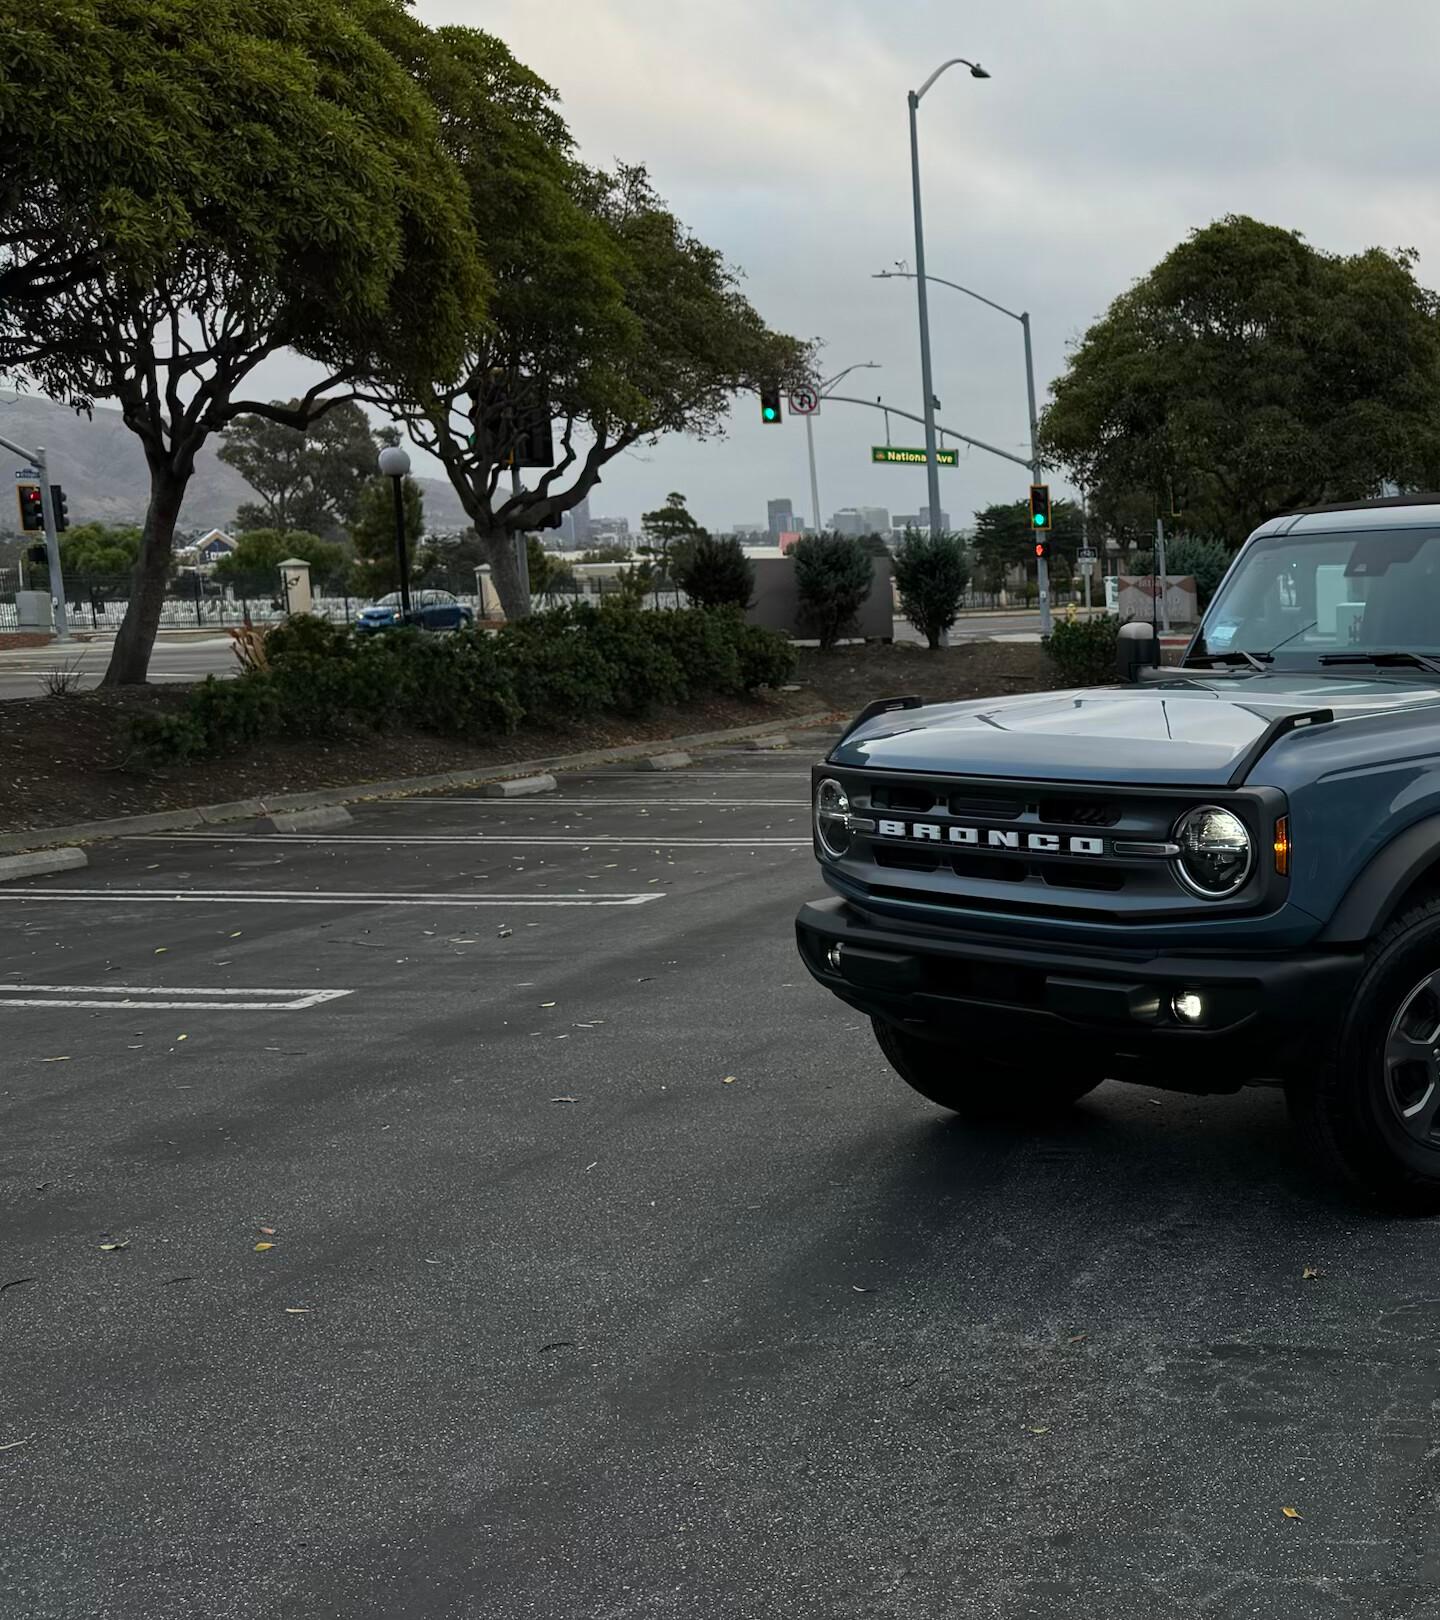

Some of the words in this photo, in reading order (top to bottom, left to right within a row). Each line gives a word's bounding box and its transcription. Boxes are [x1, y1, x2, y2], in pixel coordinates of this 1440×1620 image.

[887, 451, 928, 463] Nationa
[936, 454, 953, 464] Ave
[878, 819, 1104, 855] BRONCO
